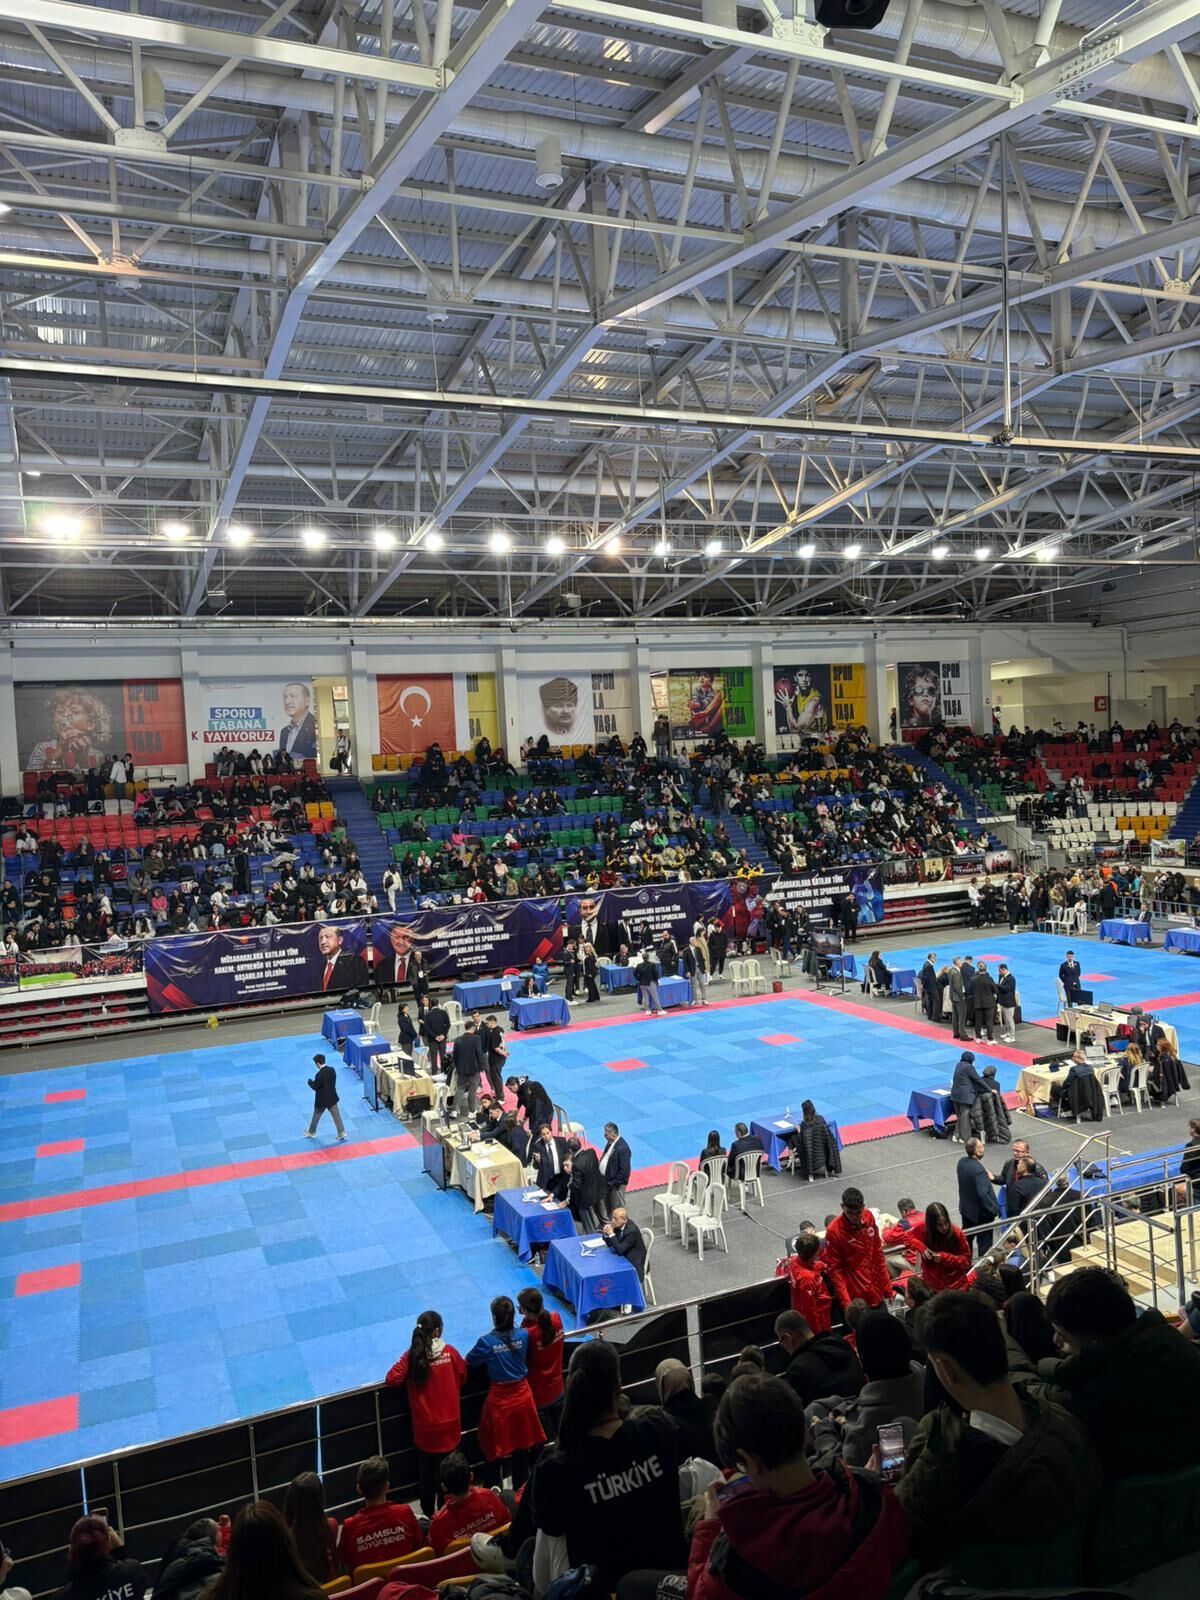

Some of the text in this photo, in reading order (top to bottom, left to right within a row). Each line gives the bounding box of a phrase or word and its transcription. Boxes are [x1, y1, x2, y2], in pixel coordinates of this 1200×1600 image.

[942, 662, 960, 678] SPOR
[591, 671, 615, 690] SPOR
[943, 680, 952, 695] LA
[834, 683, 844, 698] LA
[593, 692, 604, 709] LA
[943, 700, 962, 717] YAŞA
[214, 709, 255, 718] SPORU
[211, 720, 262, 731] TABANA
[593, 714, 617, 734] YAŞA
[205, 731, 273, 742] YAYIYORUZ
[583, 1455, 663, 1504] TÜRKİYE
[356, 1525, 405, 1545] SAMSUN
